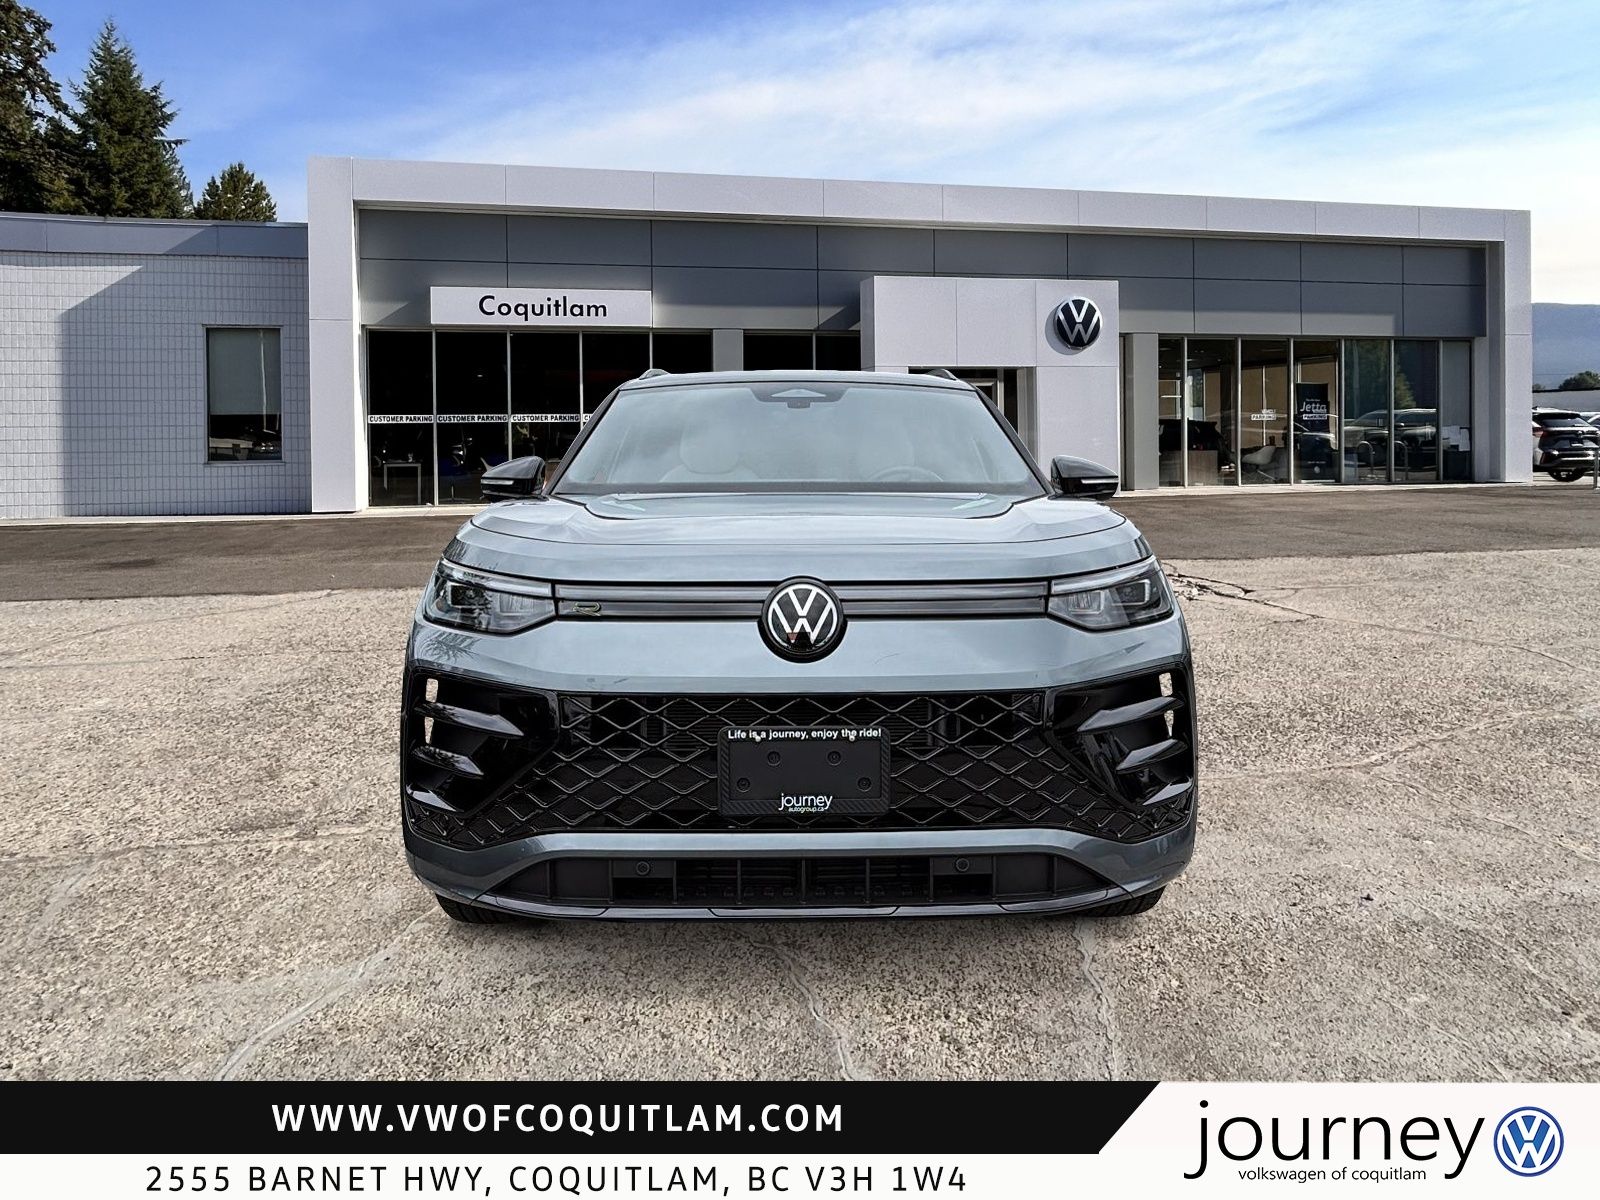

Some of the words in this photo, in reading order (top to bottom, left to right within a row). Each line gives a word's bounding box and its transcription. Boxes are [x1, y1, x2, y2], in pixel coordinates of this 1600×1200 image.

[478, 295, 608, 322] Coquitlam
[1300, 401, 1326, 412] Jetta
[369, 415, 404, 423] CUSTOMER
[405, 415, 433, 423] PARKING
[727, 730, 747, 739] Life
[749, 729, 759, 739] is
[760, 730, 767, 739] a
[768, 729, 809, 740] journey,
[810, 728, 839, 740] enjoy
[841, 728, 857, 738] the
[859, 727, 882, 738] ride!
[778, 793, 833, 811] journey
[788, 806, 825, 814] autogroup.ca
